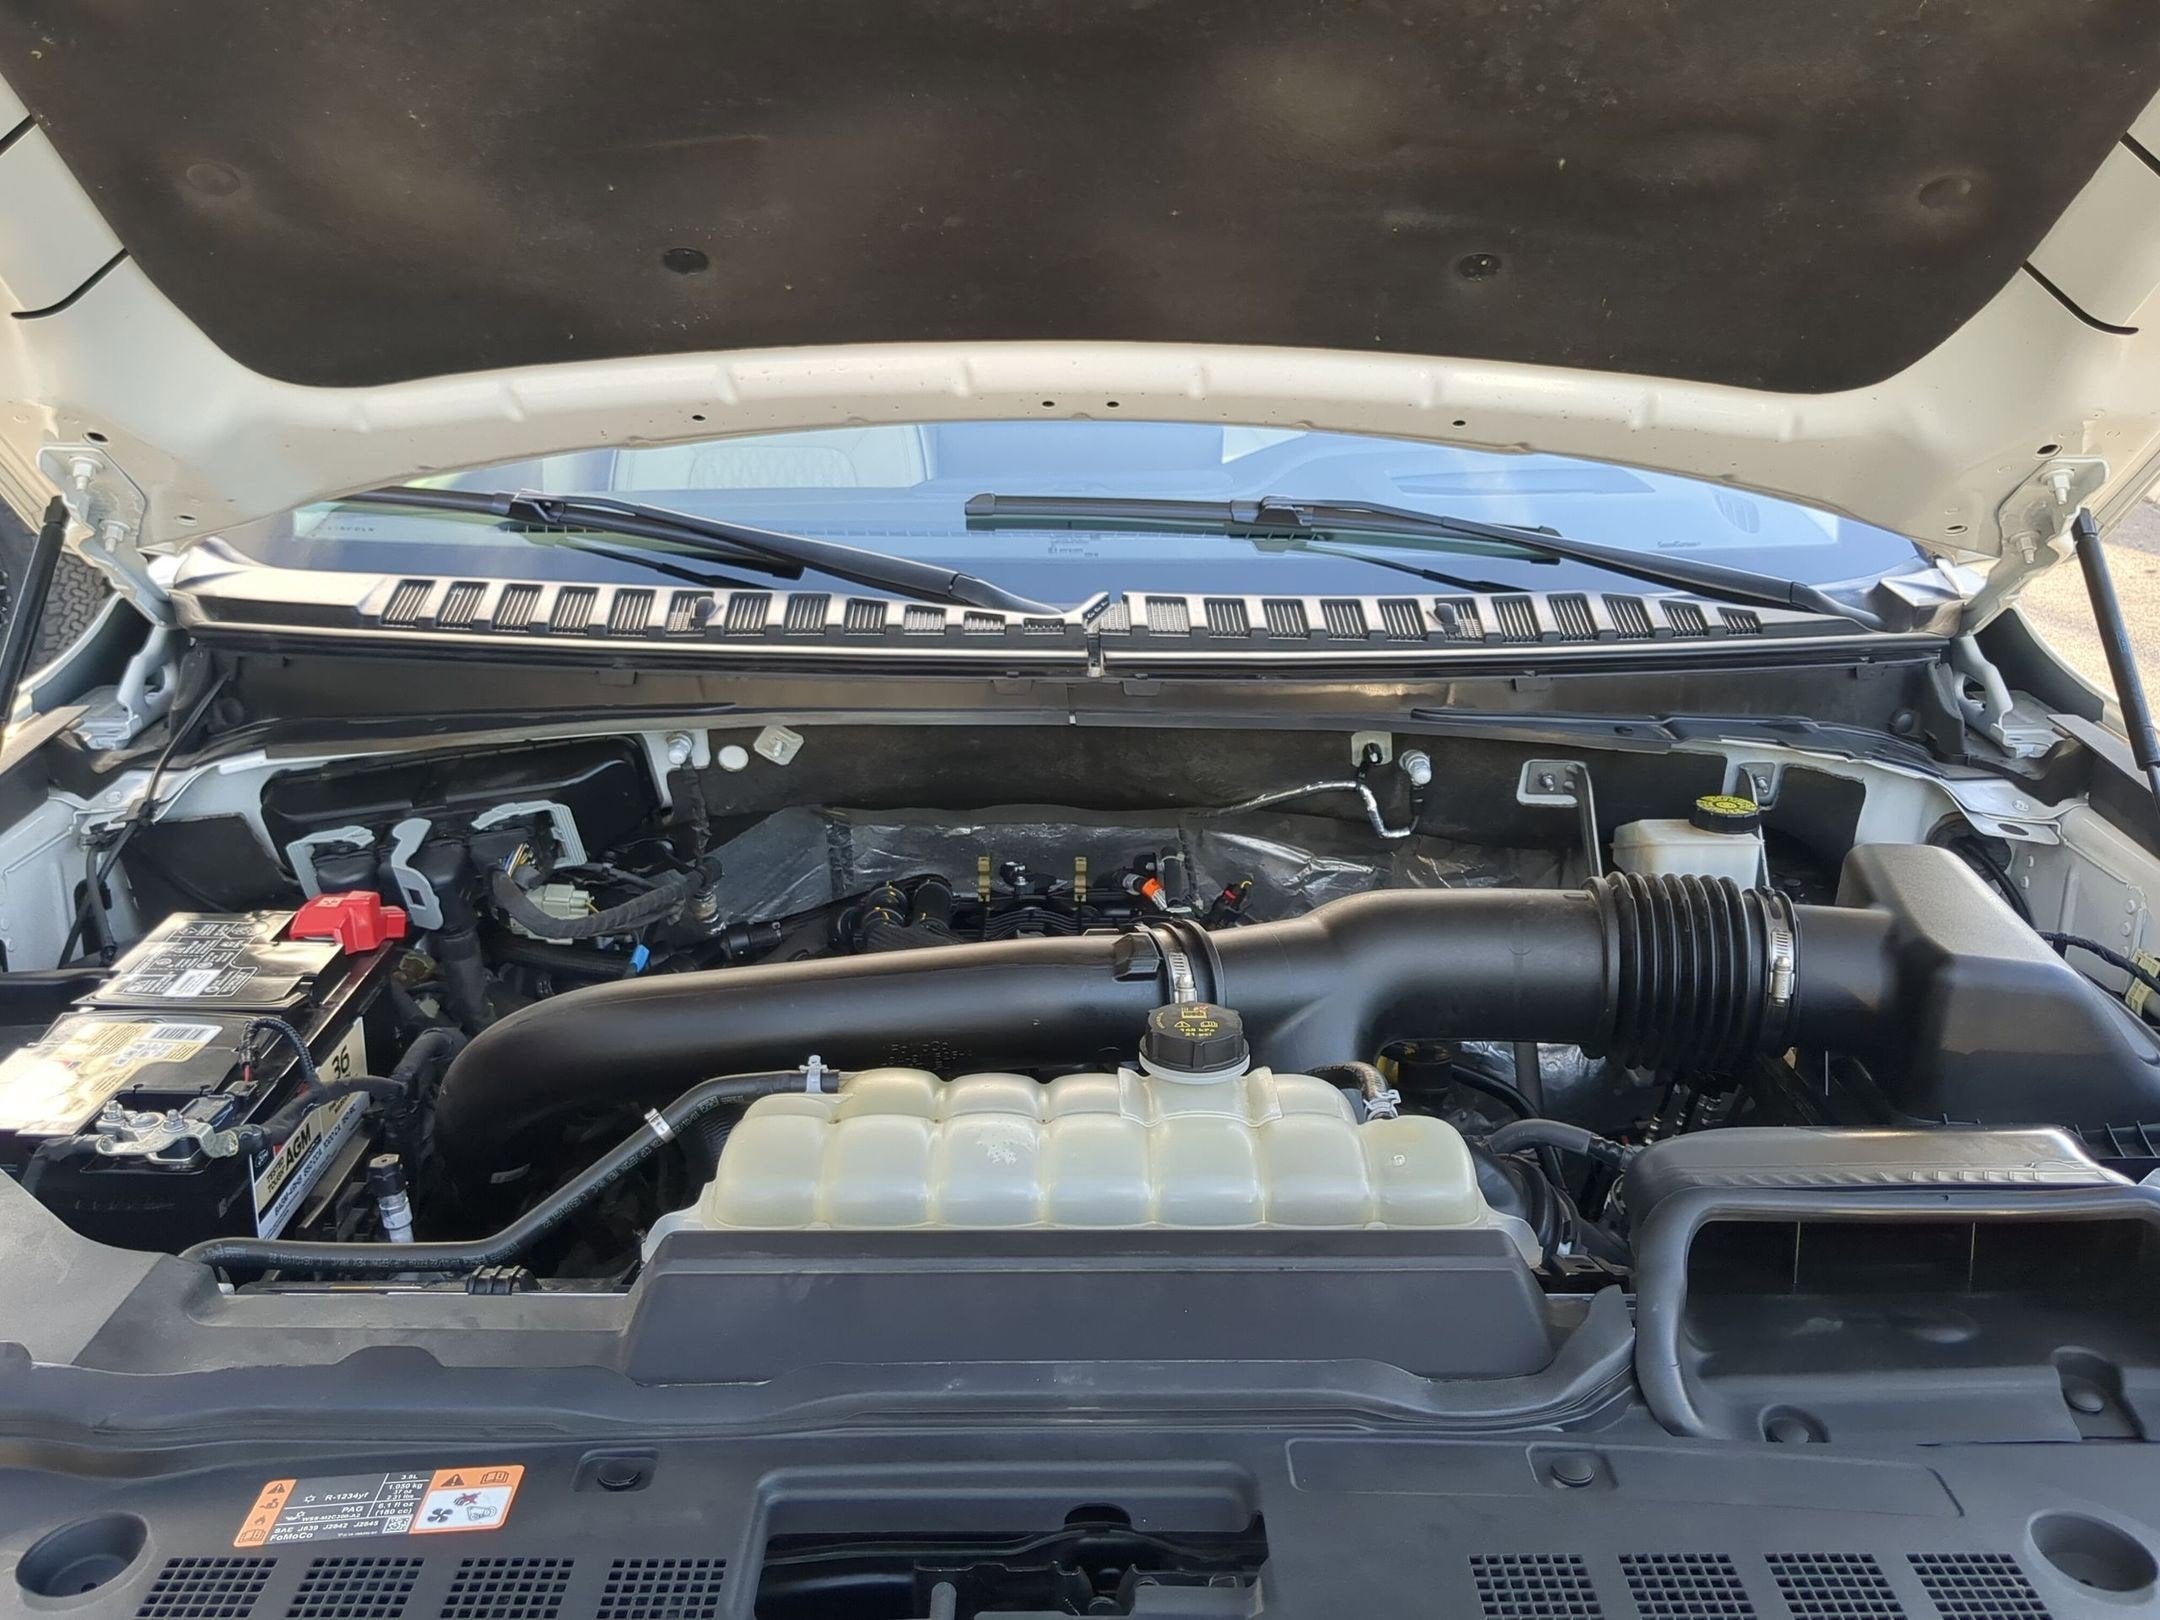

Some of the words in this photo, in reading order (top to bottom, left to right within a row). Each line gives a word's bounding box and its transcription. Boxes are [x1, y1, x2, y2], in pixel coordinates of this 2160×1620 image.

[332, 1045, 350, 1079] 36
[285, 1122, 312, 1171] AGM
[324, 1491, 370, 1501] R-1234yf
[341, 1505, 364, 1513] PAG
[269, 1532, 314, 1541] FoMoCo
